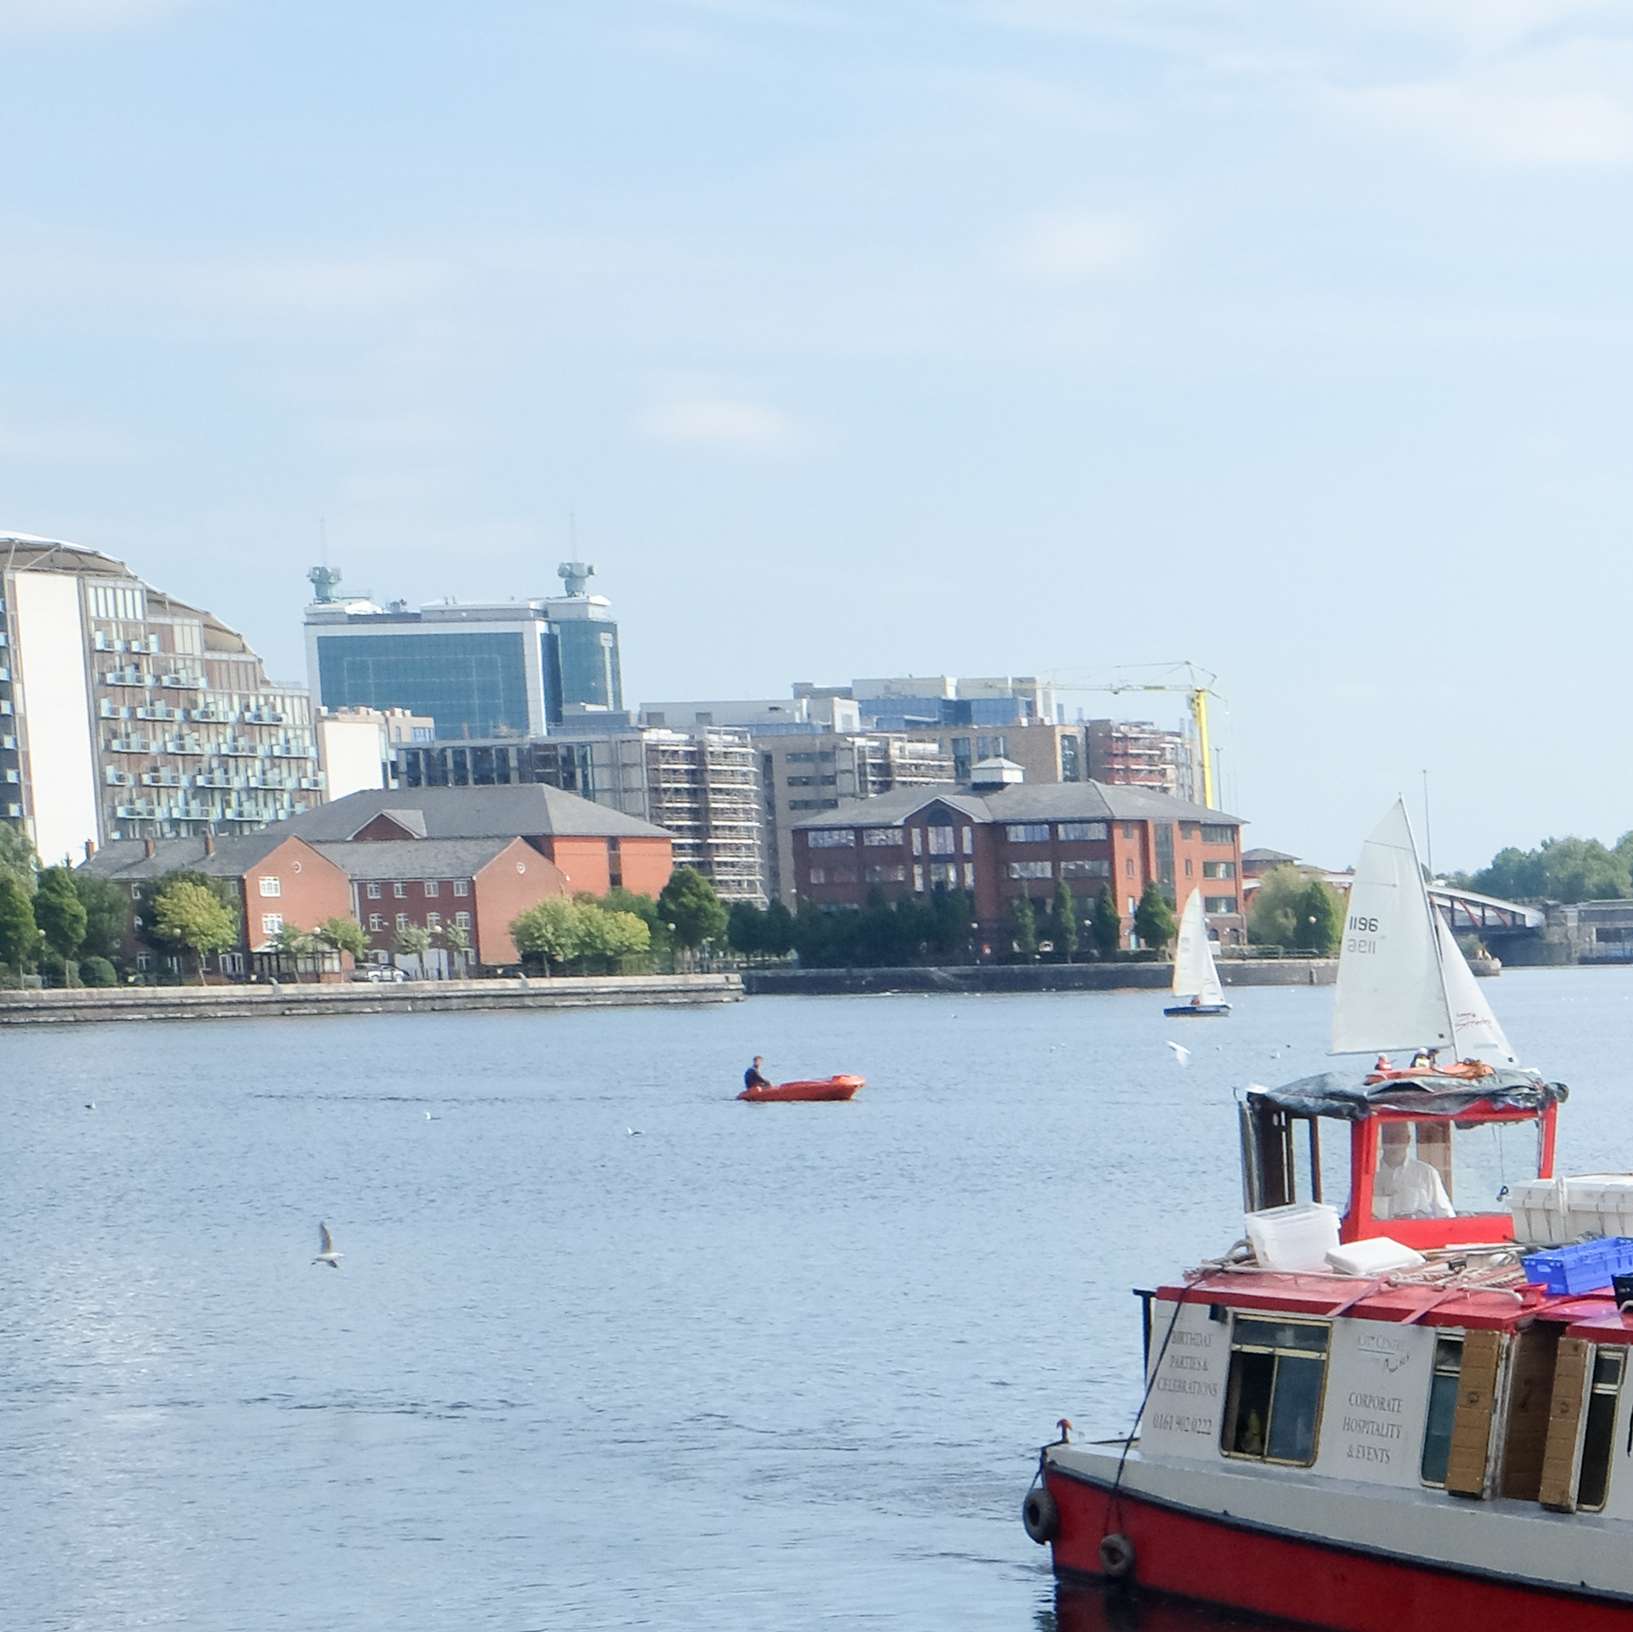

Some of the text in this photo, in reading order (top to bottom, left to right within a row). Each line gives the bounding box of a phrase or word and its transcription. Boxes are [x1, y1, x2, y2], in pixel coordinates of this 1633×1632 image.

[1350, 915, 1379, 932] 1196
[1348, 1392, 1403, 1413] CORPORATE
[1342, 1416, 1403, 1439] HOSPITALITY
[1347, 1445, 1391, 1464] & EVENTS
